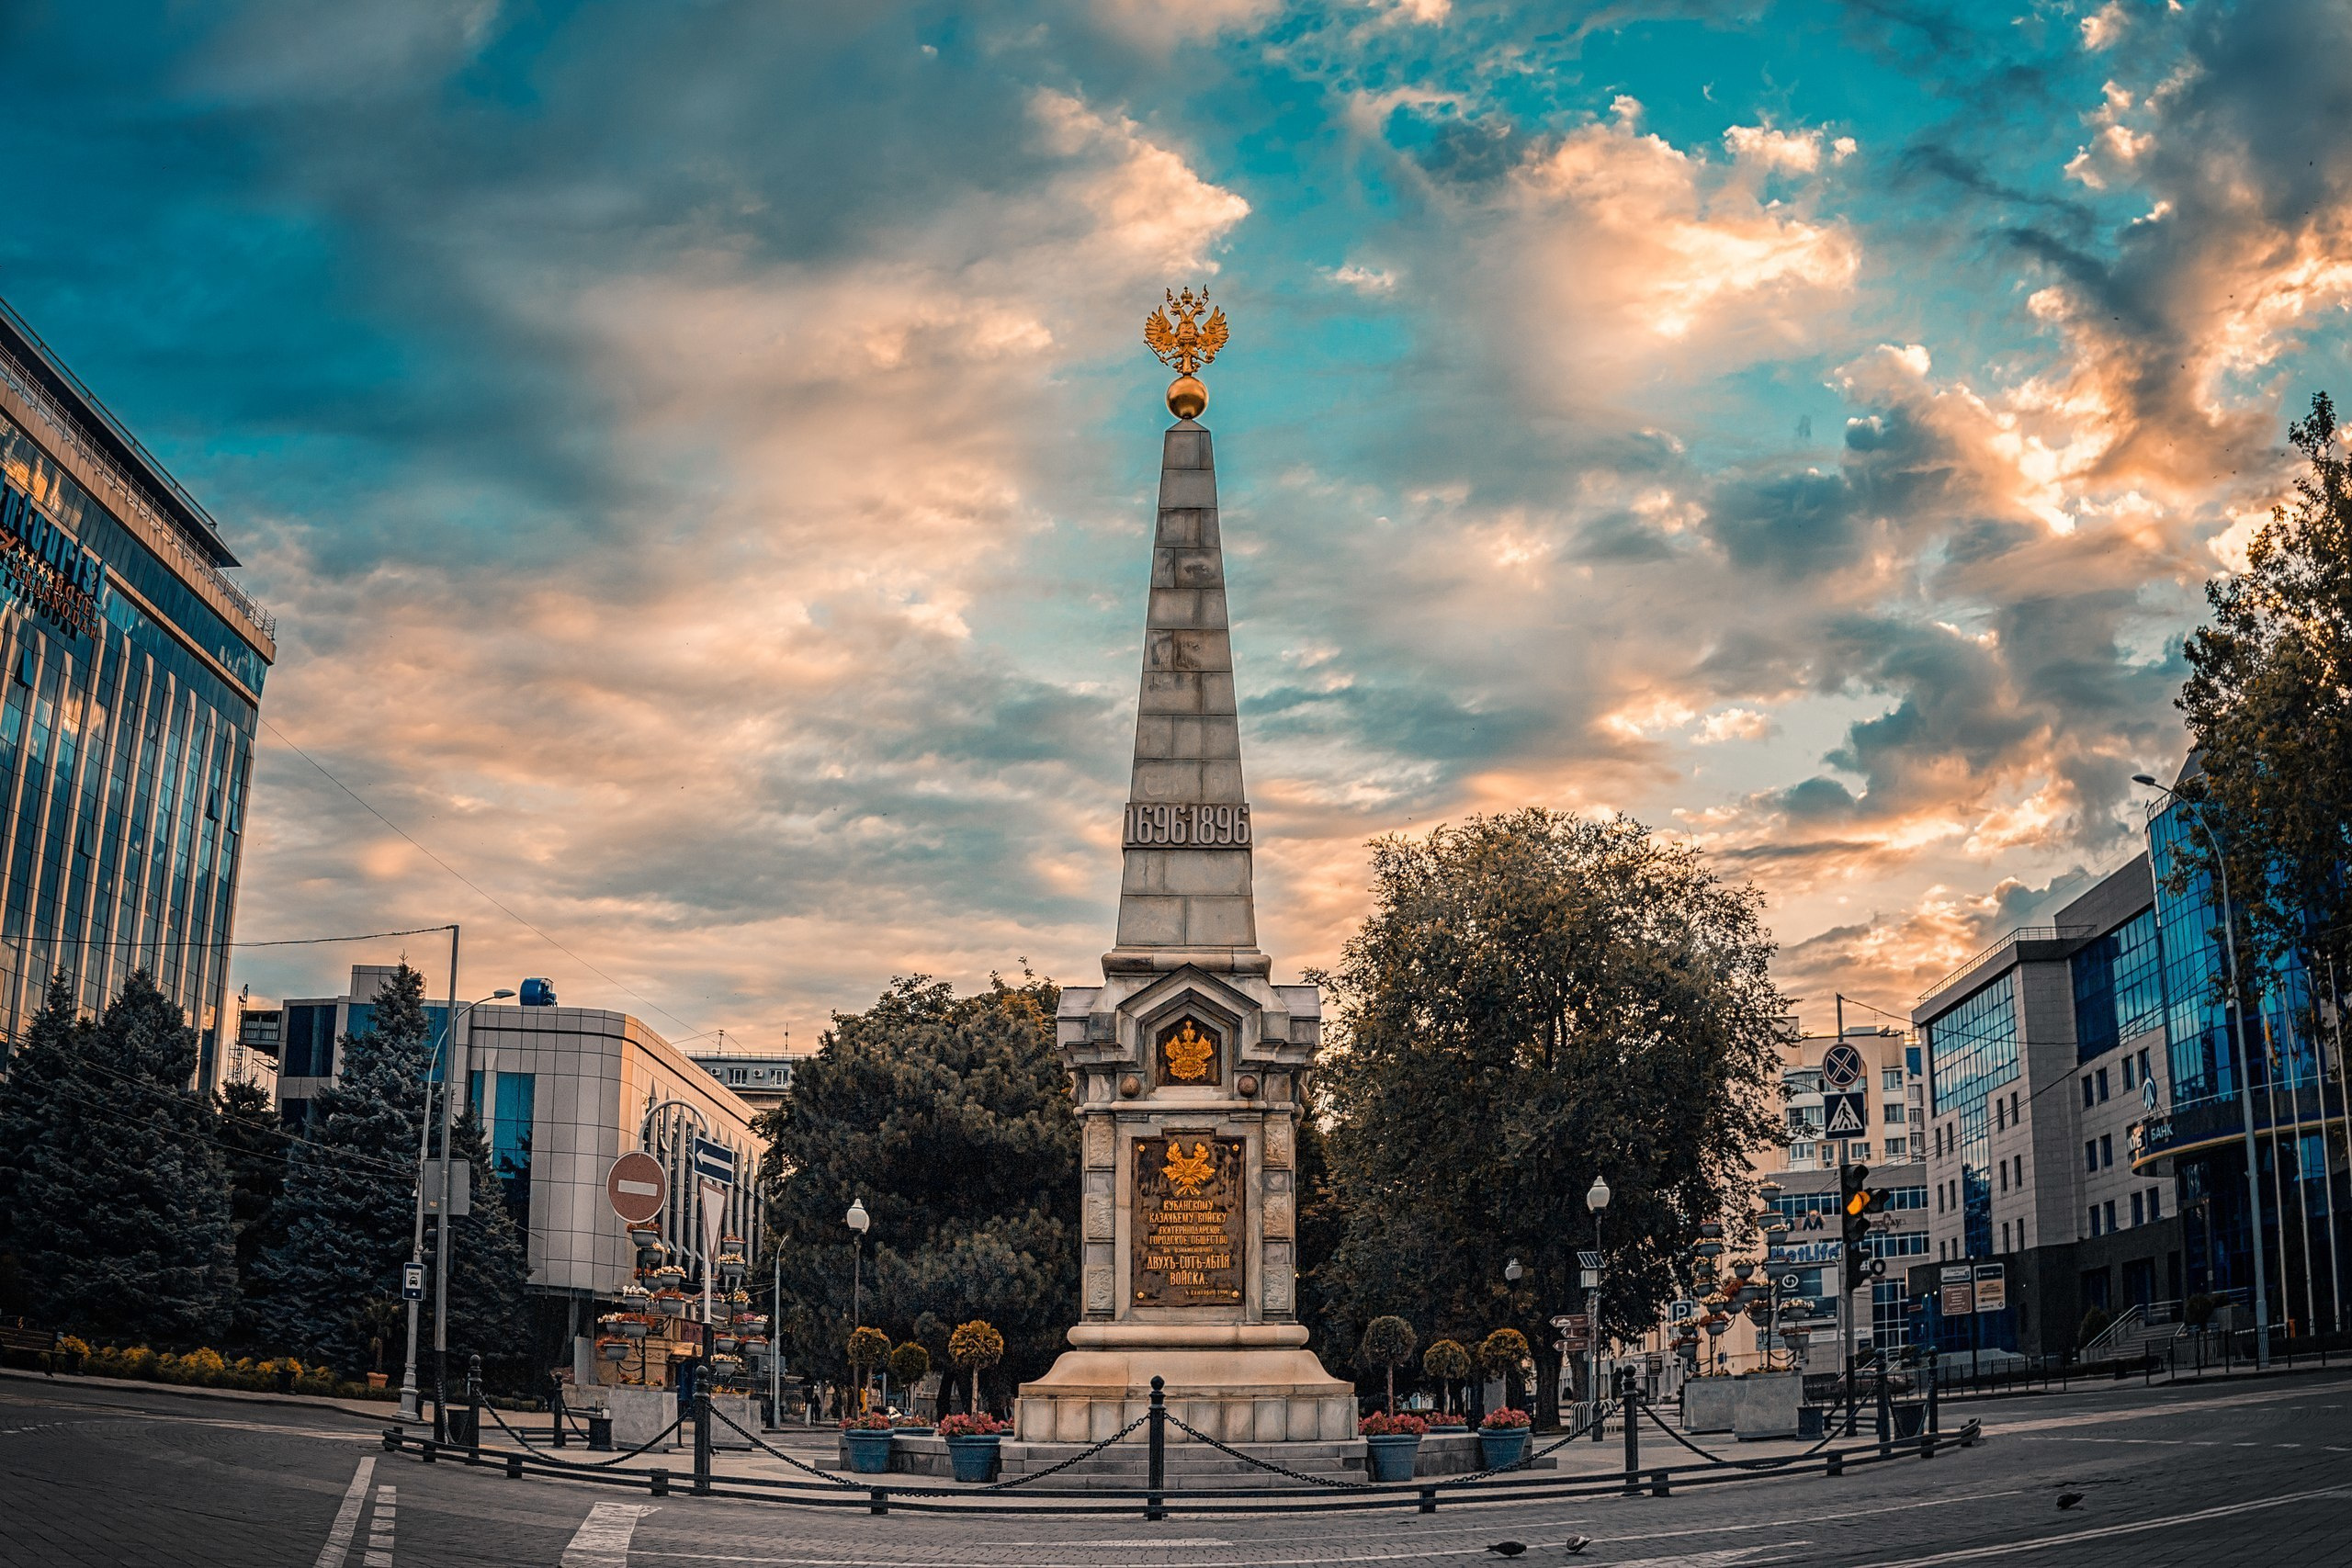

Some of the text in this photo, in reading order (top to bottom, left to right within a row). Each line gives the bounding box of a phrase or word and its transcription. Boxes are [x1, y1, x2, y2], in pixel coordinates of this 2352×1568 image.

[13, 561, 97, 641] KRASNODAR
[56, 575, 100, 623] HOTEL
[2151, 1123, 2174, 1141] БАНК
[1163, 1200, 1214, 1211] КУБАНСКОМУ
[1149, 1211, 1227, 1223] КАЗАЧЬЕМУ ВОЙСКУ
[1149, 1235, 1228, 1245] ГОРОДСКОЕ ОБЩЕСТВО
[1170, 1269, 1208, 1286] ВОЙСКА.
